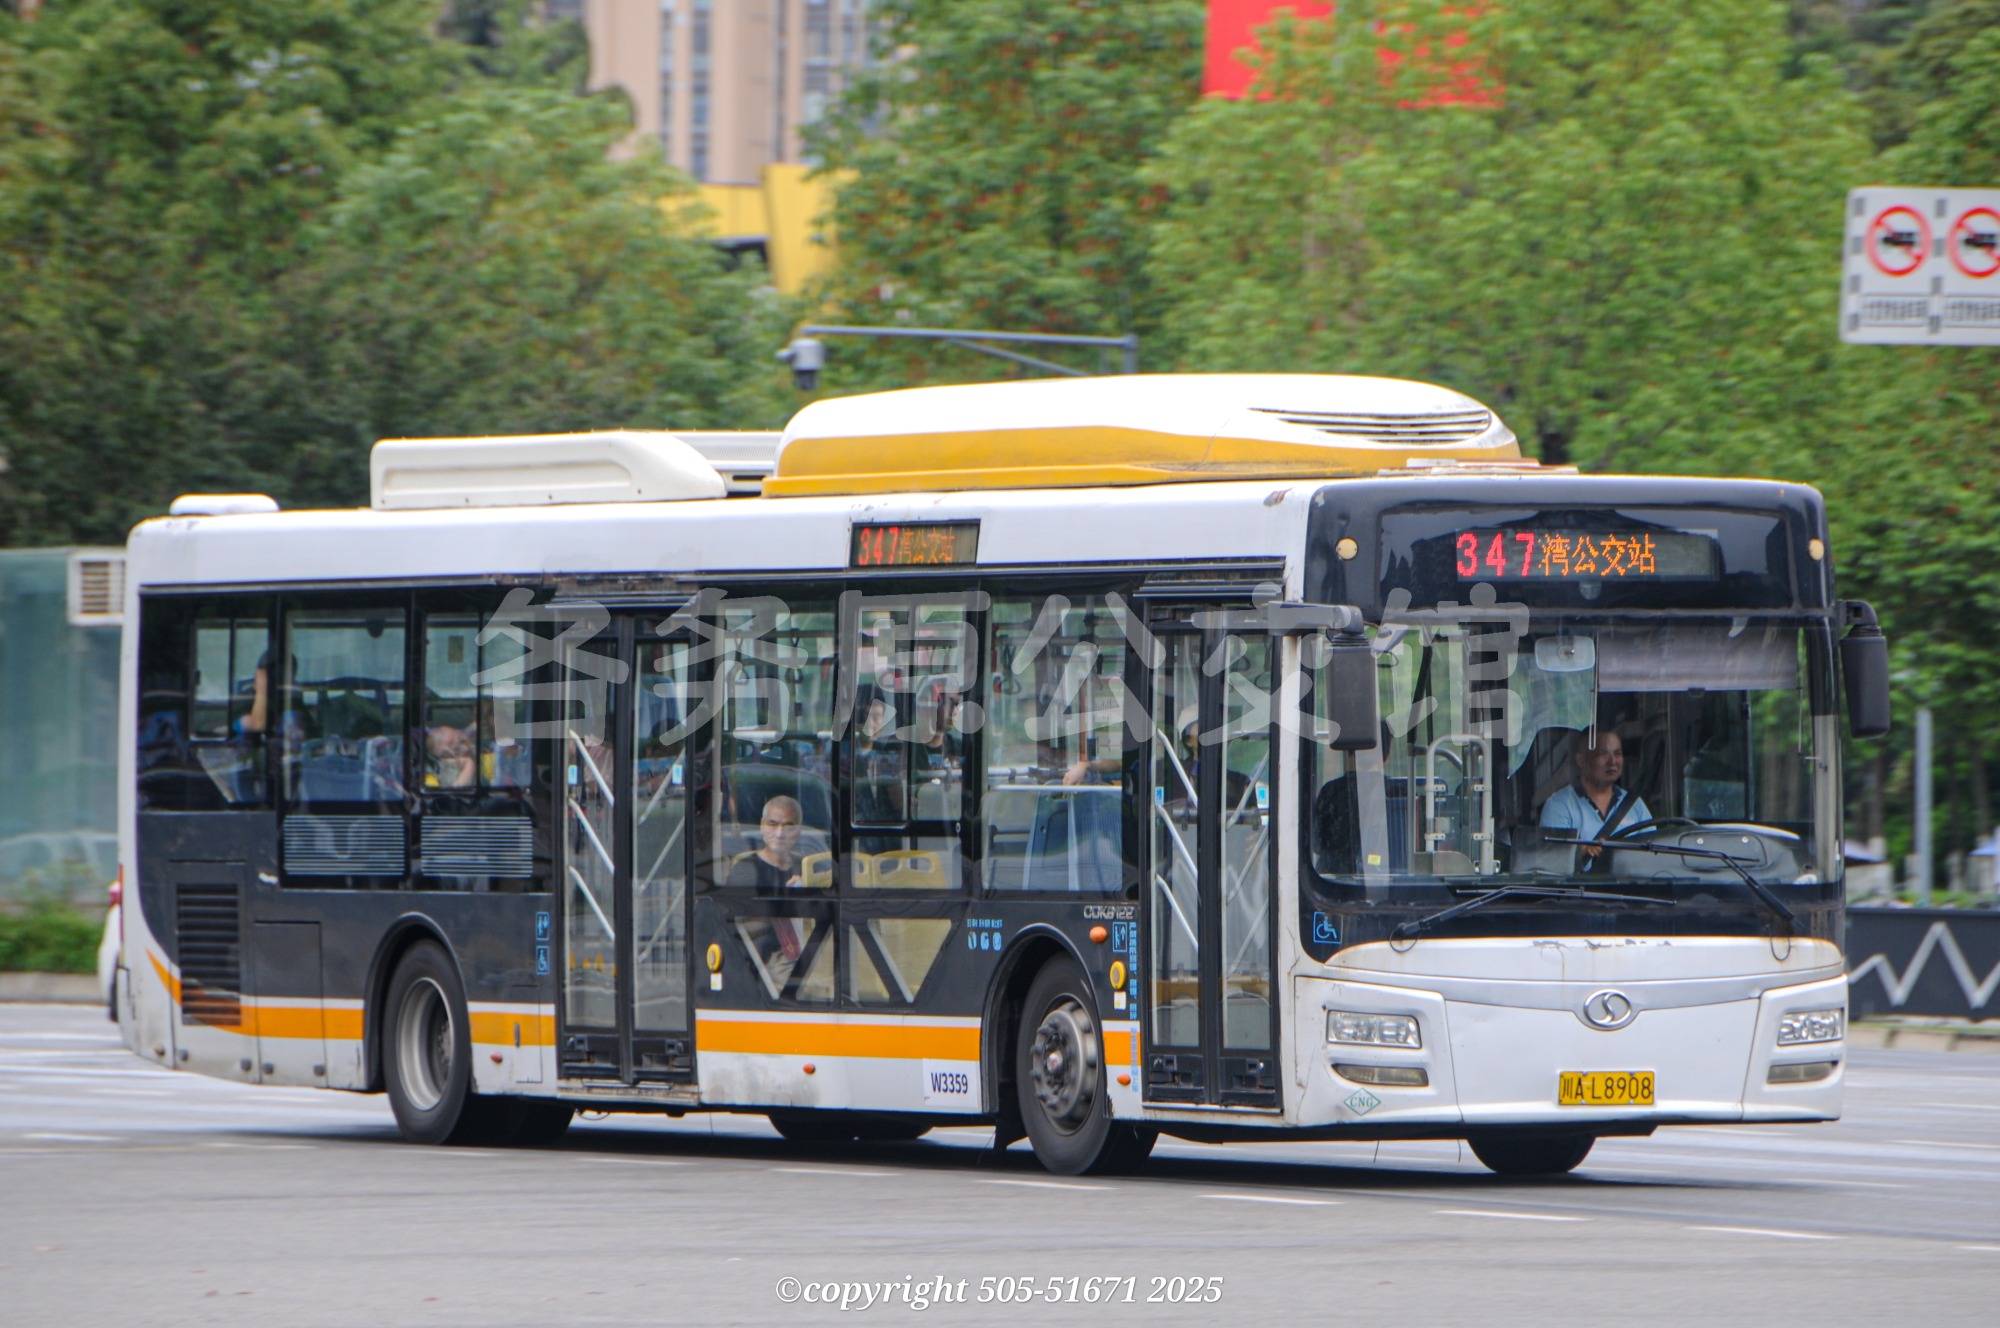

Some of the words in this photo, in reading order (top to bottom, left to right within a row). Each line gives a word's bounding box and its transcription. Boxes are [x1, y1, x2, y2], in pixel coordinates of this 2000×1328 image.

[858, 526, 900, 566] 347
[1456, 532, 1535, 577] 347
[1537, 532, 1656, 577] 湾公交站
[930, 1072, 969, 1095] W3359
[1350, 1097, 1374, 1108] CNG
